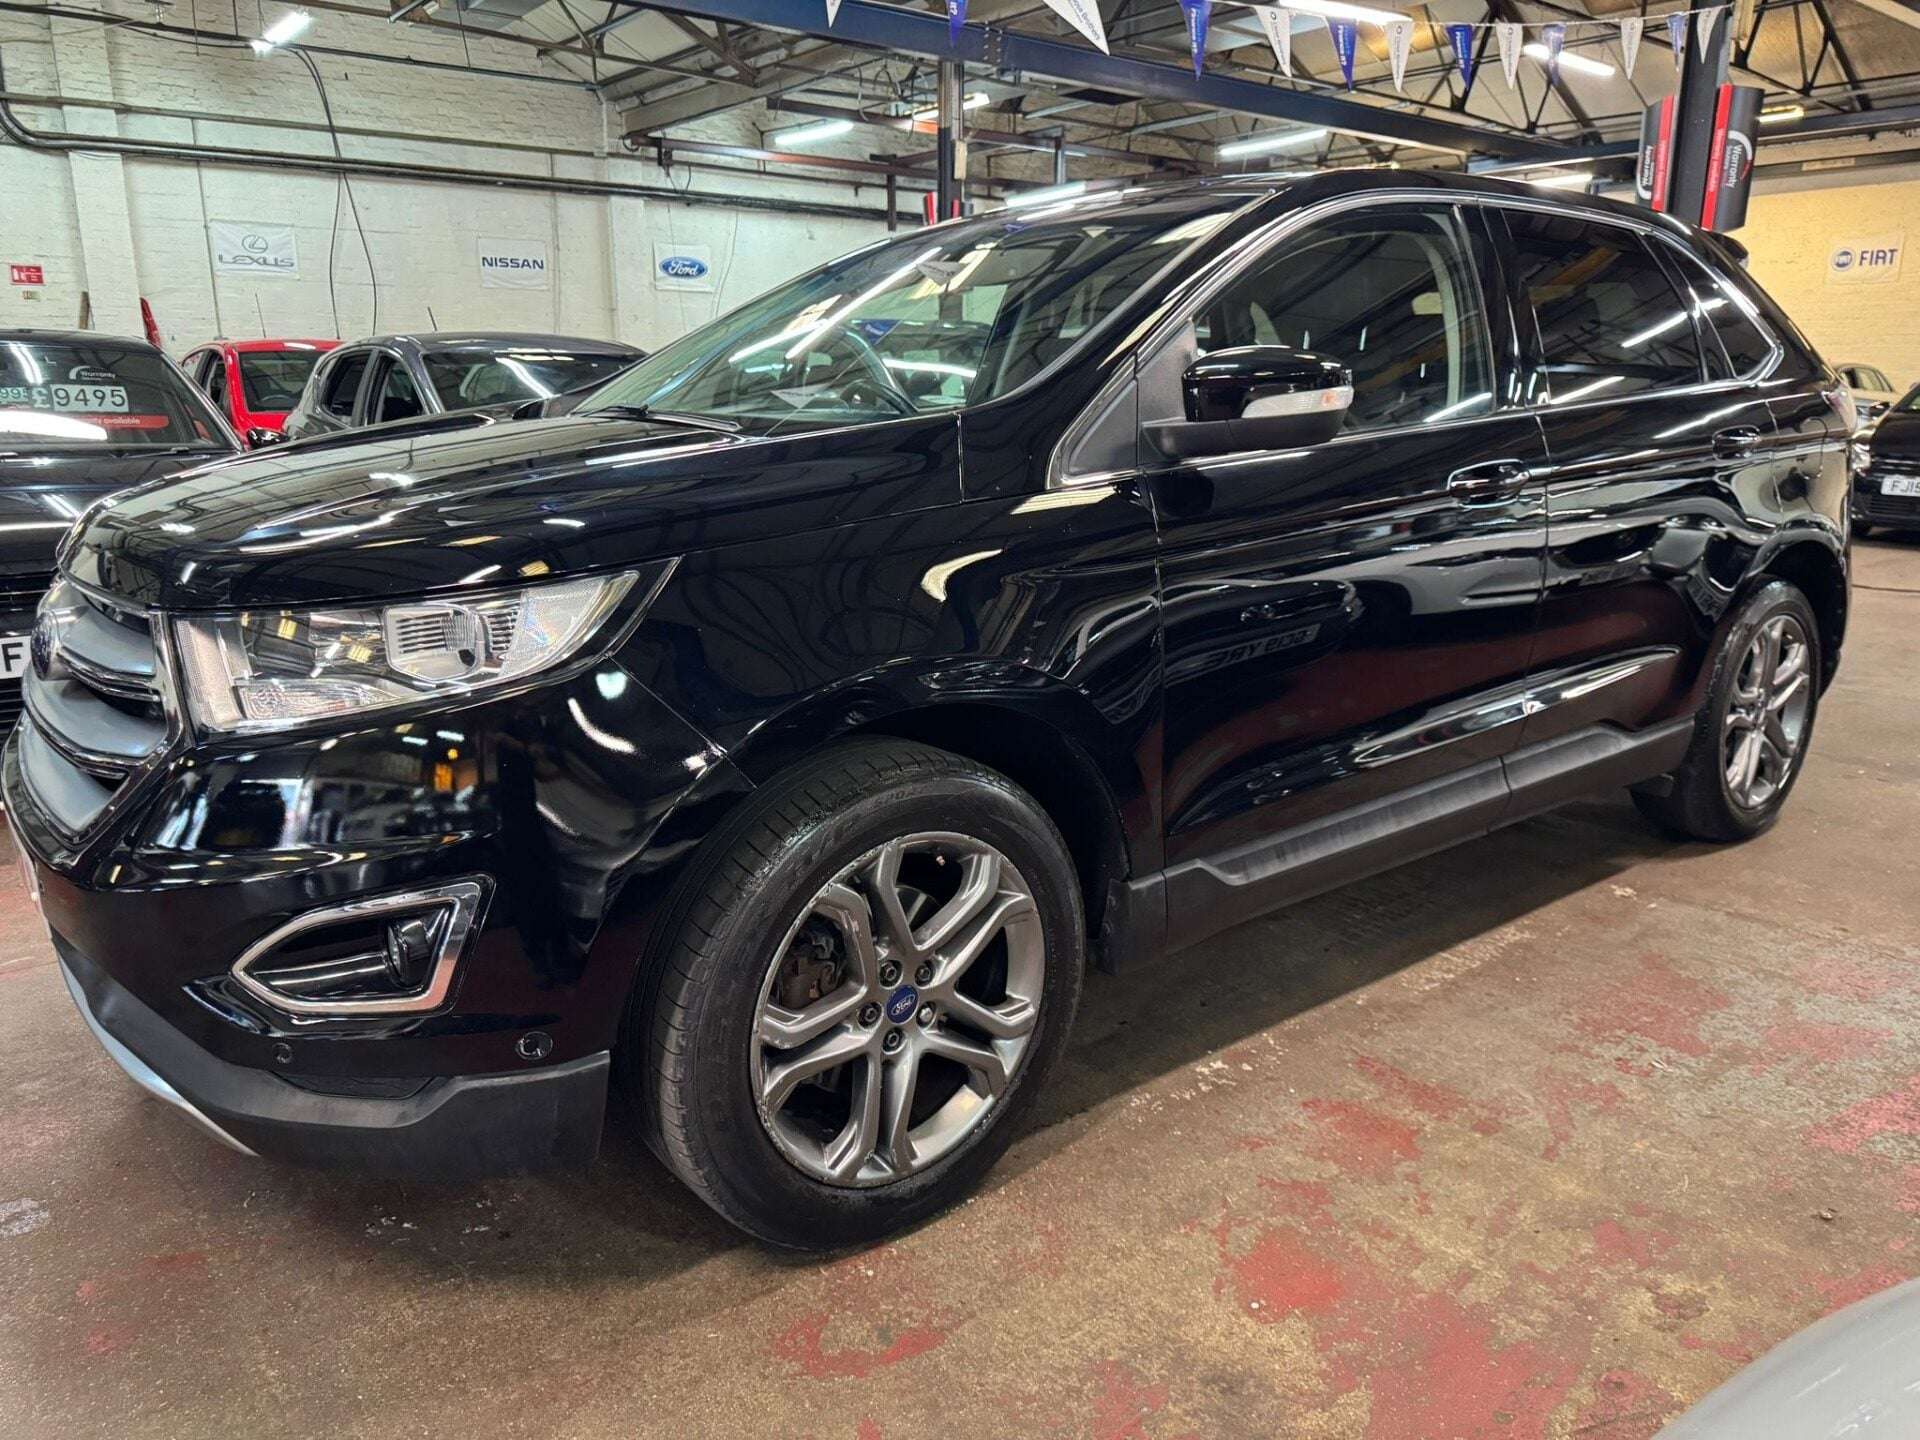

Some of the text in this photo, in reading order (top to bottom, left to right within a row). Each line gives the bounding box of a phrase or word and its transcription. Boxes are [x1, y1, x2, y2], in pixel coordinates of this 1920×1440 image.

[1726, 144, 1744, 188] Warranty
[218, 254, 295, 268] LEXUS
[481, 256, 544, 270] NISSAN
[1859, 248, 1898, 267] FIAT
[668, 260, 700, 276] Ford
